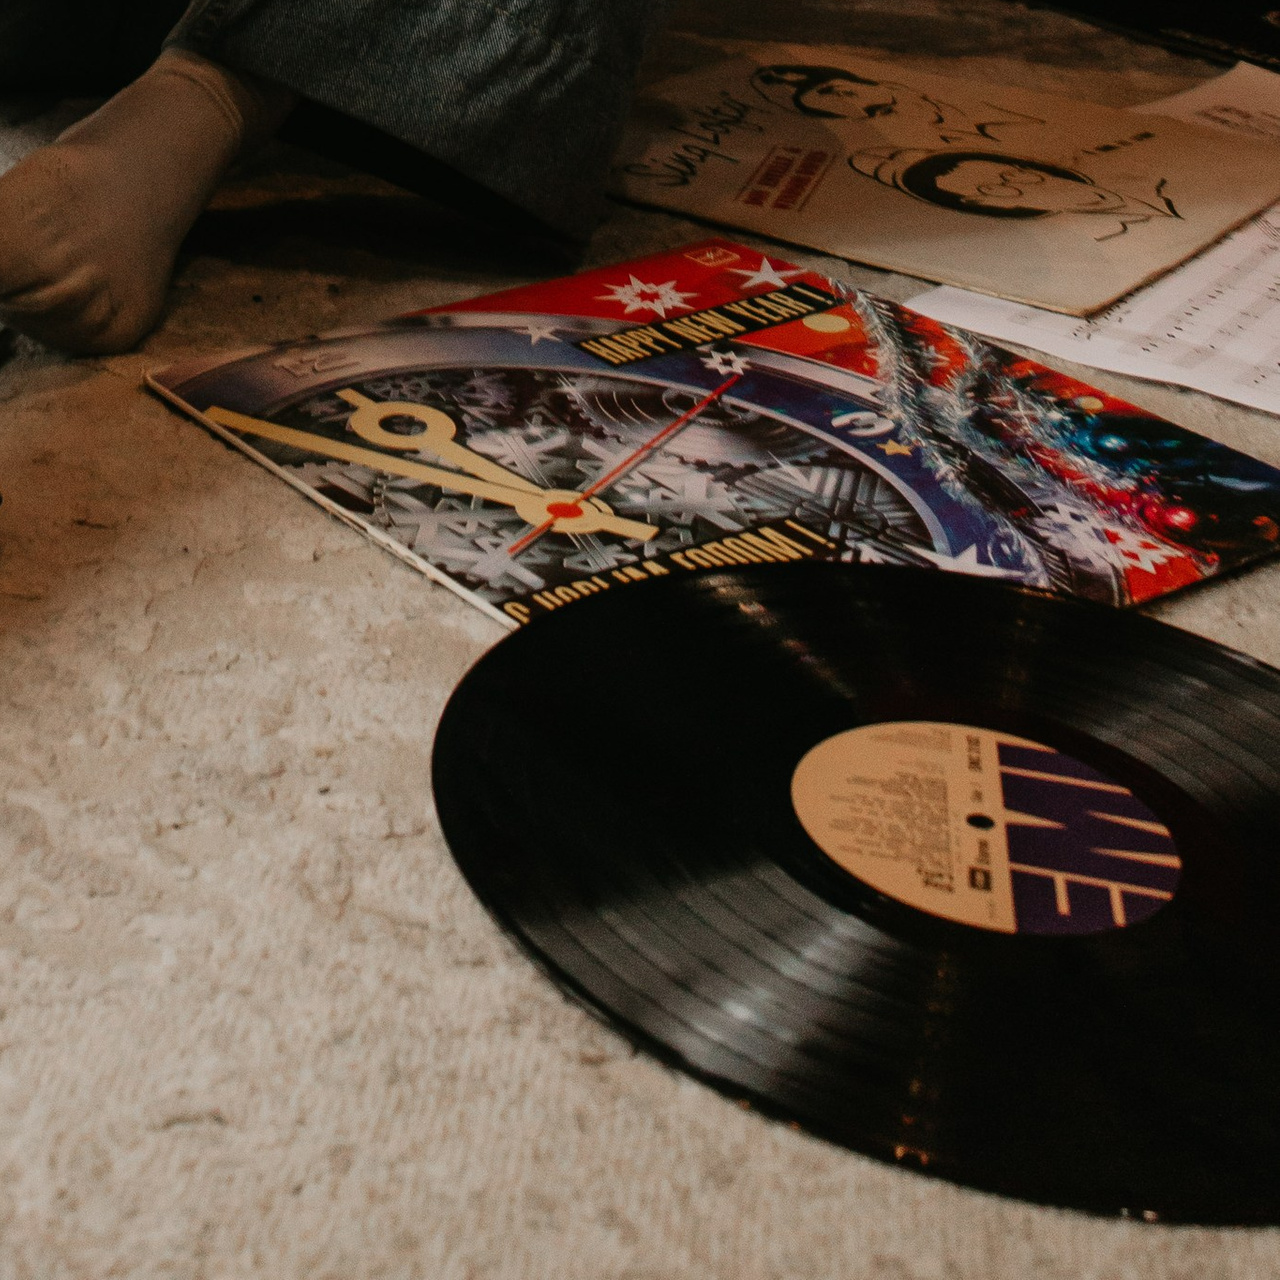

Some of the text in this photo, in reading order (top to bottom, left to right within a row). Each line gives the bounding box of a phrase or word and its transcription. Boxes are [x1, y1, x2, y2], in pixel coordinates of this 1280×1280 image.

[580, 327, 682, 365] HAPPY
[663, 310, 746, 342] NEW
[724, 293, 815, 325] YEAR
